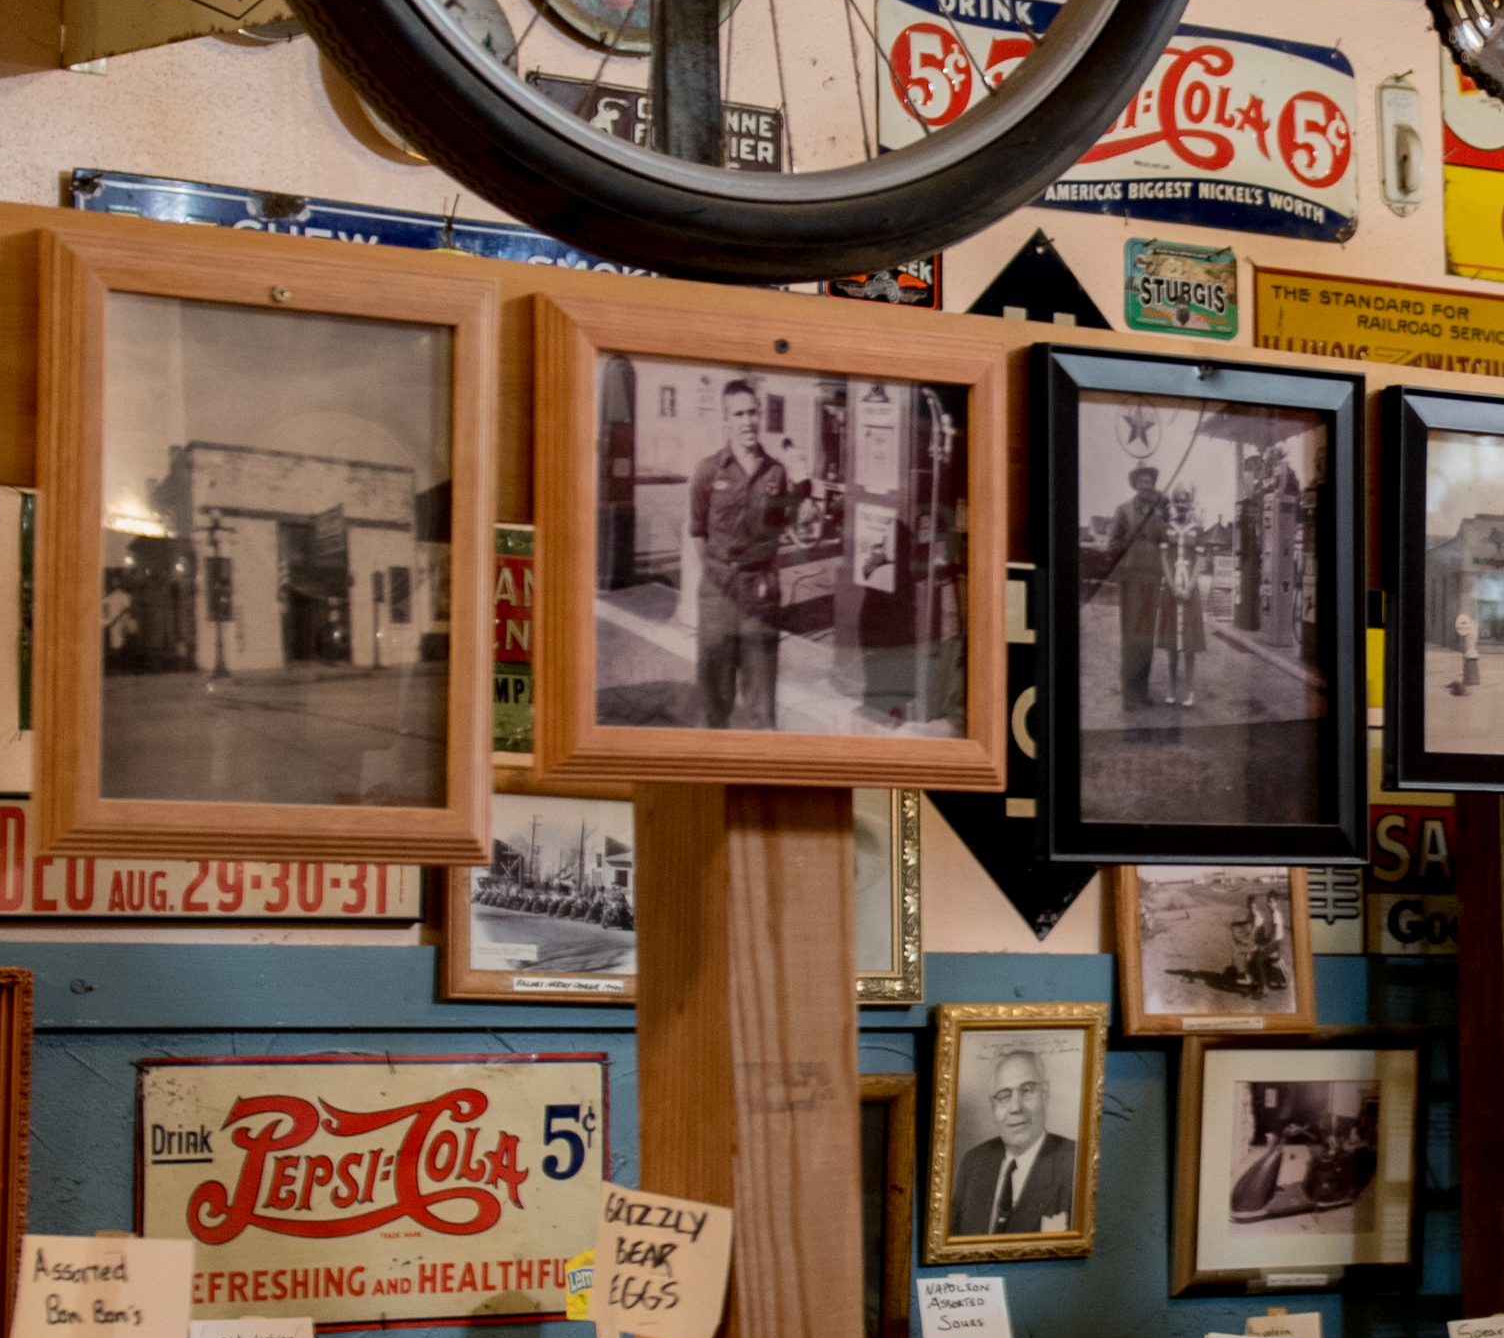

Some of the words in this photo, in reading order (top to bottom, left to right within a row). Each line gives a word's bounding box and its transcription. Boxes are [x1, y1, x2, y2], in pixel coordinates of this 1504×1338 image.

[1044, 180, 1123, 201] AMERICA'S
[1127, 181, 1193, 202] BIGGEST
[1198, 185, 1264, 207] NICKEL'S
[1267, 191, 1325, 225] WORTH
[1138, 276, 1226, 314] STURGIS
[1271, 285, 1311, 303] THE
[1319, 291, 1425, 317] STANDARD
[1432, 303, 1470, 321] FOR
[1357, 315, 1442, 337] RAILROAD
[108, 870, 175, 912] AUG.
[152, 1124, 212, 1156] Drink
[614, 1236, 677, 1276] BEAR
[372, 1276, 412, 1296] AND
[609, 1277, 680, 1311] EGGS
